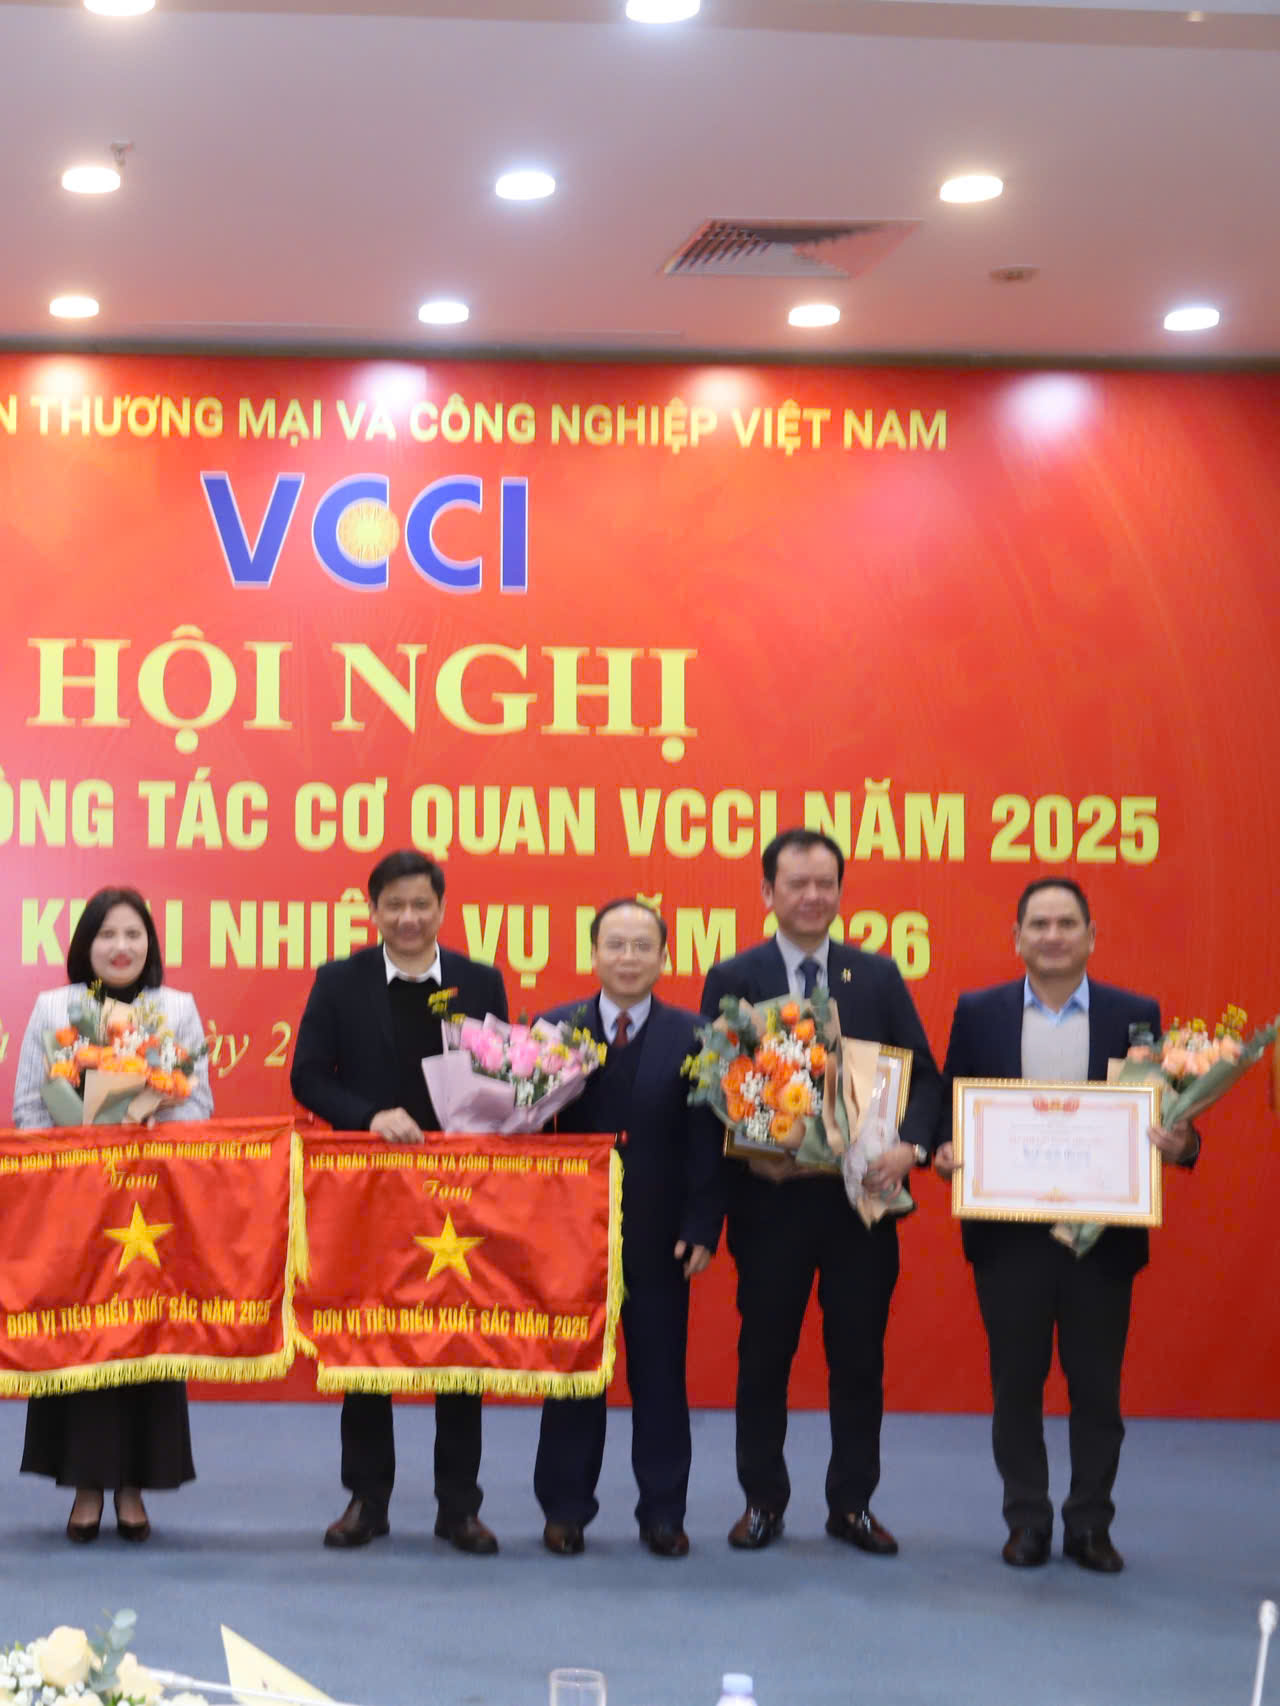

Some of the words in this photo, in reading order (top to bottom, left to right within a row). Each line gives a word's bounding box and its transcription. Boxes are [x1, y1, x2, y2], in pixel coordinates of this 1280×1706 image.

[30, 394, 224, 440] THƯƠNG
[238, 397, 322, 447] MẠI
[409, 393, 536, 444] CÔNG
[551, 397, 718, 455] NGHIỆP
[731, 399, 831, 456] VIỆT
[843, 408, 948, 450] NAM
[200, 471, 529, 595] VCCI
[26, 623, 293, 754] HỘI
[331, 642, 698, 763] NGHỊ
[138, 767, 269, 851] TÁC
[294, 777, 389, 853] CƠ
[411, 784, 597, 862] QUAN
[619, 787, 778, 858] VCCI
[803, 777, 966, 863] NĂM
[990, 795, 1160, 865] 2025
[462, 903, 550, 988] VỤ
